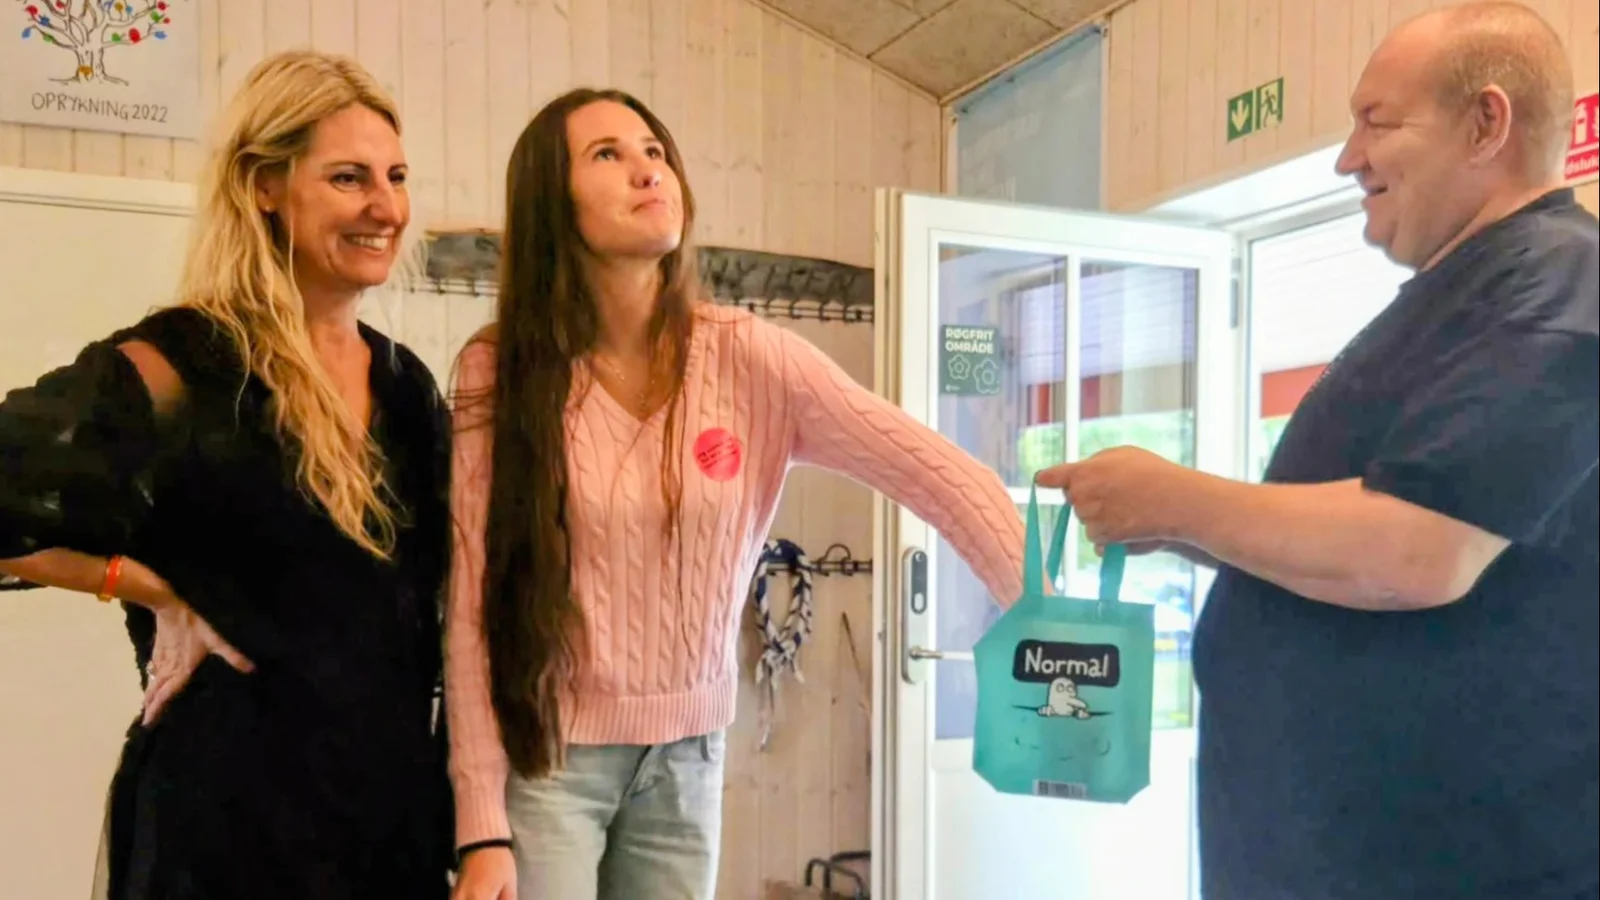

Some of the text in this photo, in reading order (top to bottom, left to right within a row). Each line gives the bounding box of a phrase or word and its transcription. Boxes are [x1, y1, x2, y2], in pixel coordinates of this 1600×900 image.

[31, 92, 168, 123] OPRYKNING 2022
[945, 327, 994, 340] RØGFRIT
[945, 340, 994, 354] OMRÅDE
[1024, 647, 1110, 678] Normal
